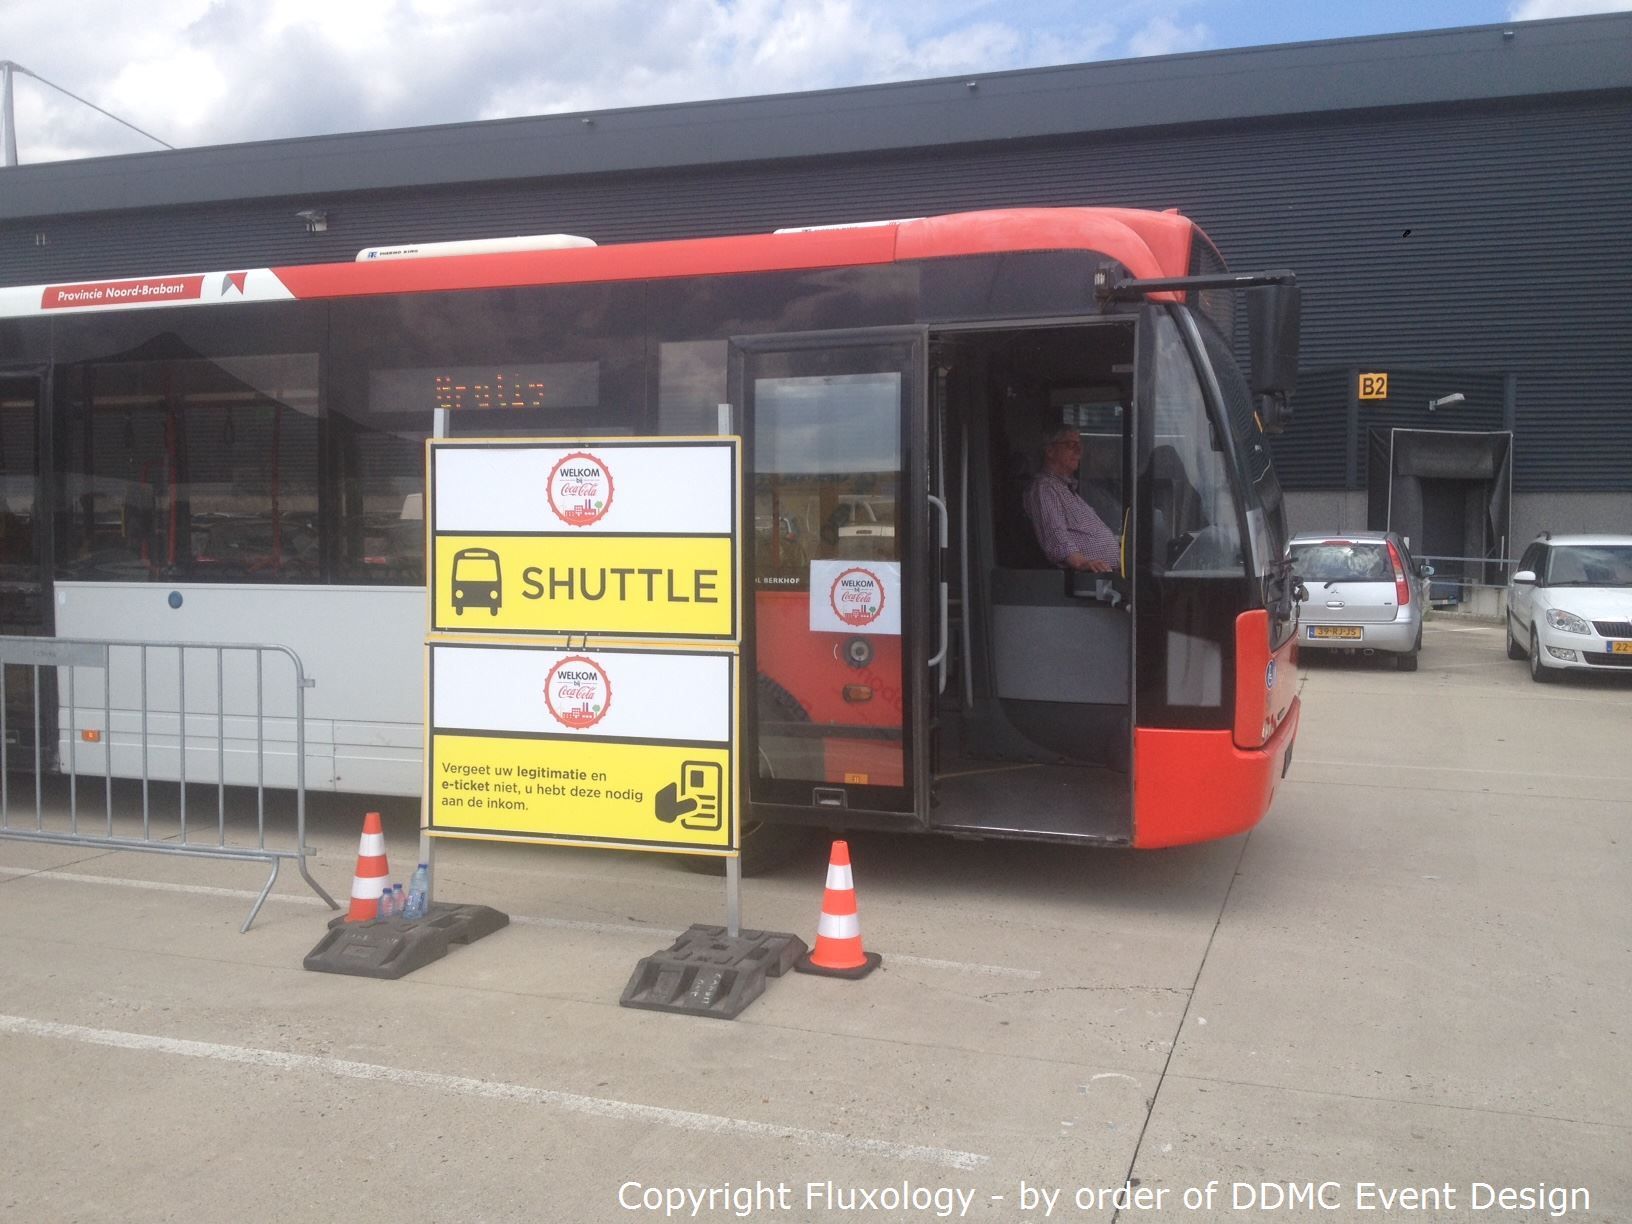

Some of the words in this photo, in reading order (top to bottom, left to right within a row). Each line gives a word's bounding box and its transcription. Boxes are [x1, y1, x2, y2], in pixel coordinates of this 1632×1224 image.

[58, 289, 102, 301] Provincie
[105, 283, 184, 298] Noord-Brabant
[1363, 377, 1385, 395] B2
[560, 468, 600, 477] WELKOM
[522, 567, 718, 603] SHUTTLE
[841, 580, 874, 588] WELKOM
[557, 671, 597, 680] WELKOM
[442, 762, 490, 776] Vergeet
[495, 767, 513, 776] uw
[517, 766, 587, 781] legitimatie
[591, 772, 607, 781] en
[442, 779, 490, 792] e-ticket
[494, 782, 521, 794] niet,
[525, 785, 533, 794] u
[537, 784, 566, 796] hebt
[570, 786, 601, 798] deze
[605, 789, 643, 803] nodig
[442, 797, 463, 807] aan
[468, 796, 483, 808] de
[487, 797, 529, 811] inkom.
